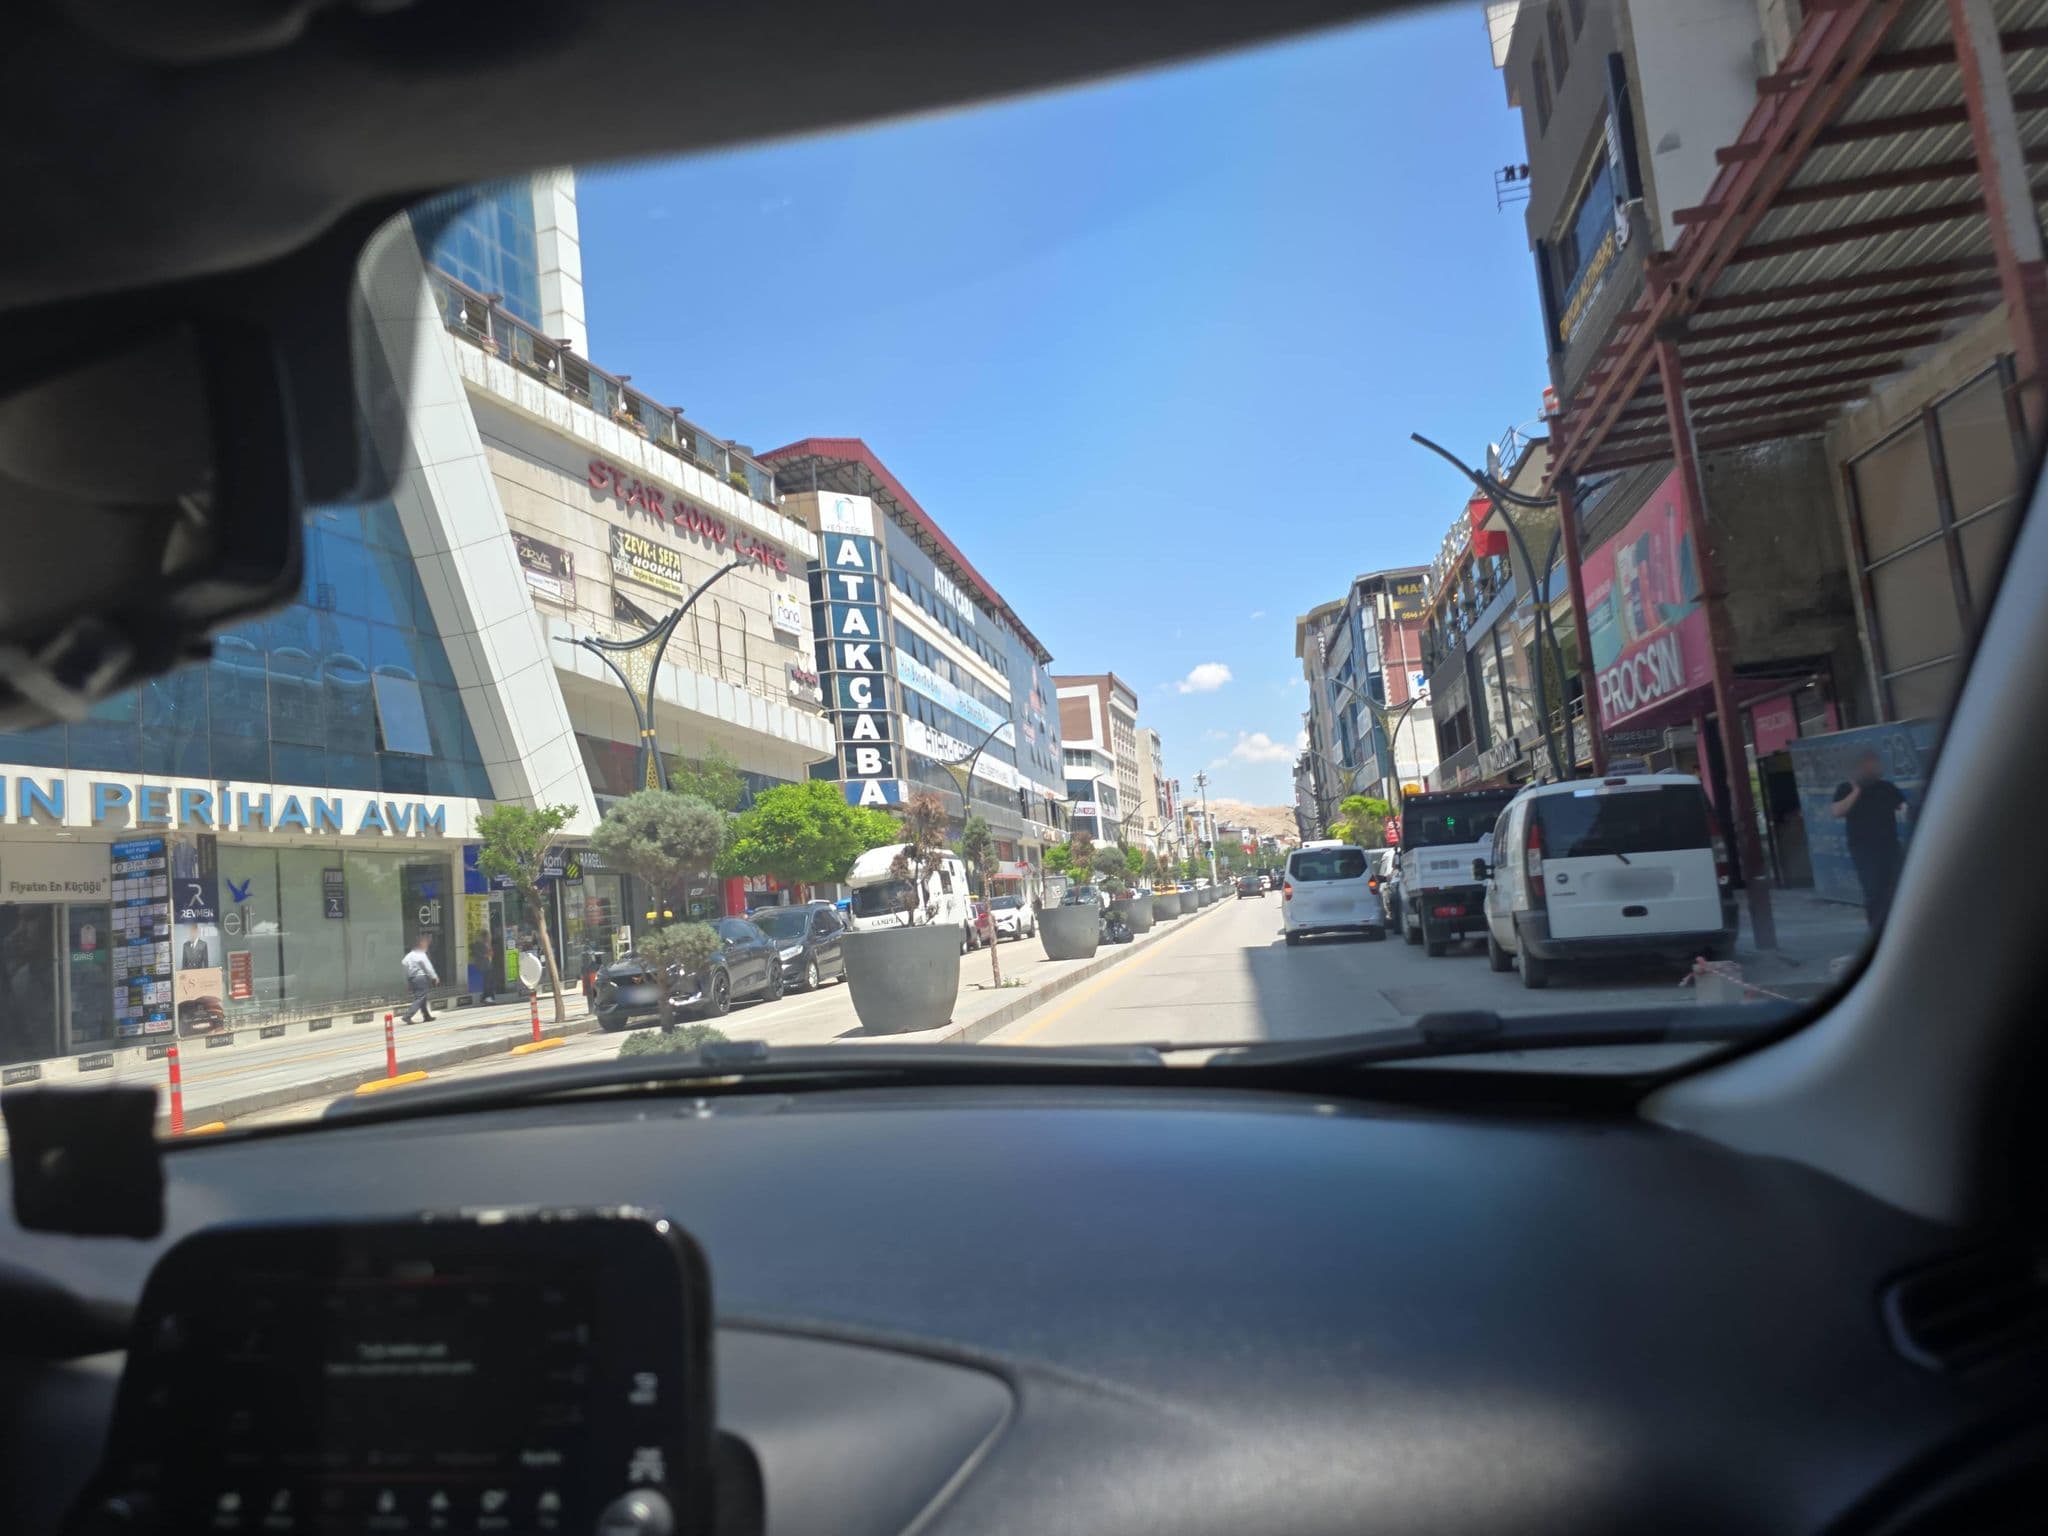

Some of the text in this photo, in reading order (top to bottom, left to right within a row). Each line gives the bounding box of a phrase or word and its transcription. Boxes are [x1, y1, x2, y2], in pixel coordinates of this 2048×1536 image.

[588, 461, 665, 520] STAR
[672, 501, 727, 544] 2000
[632, 555, 681, 582] HOOKAH
[95, 781, 343, 829] PERİHAN
[359, 800, 446, 833] AVM
[49, 881, 62, 892] En
